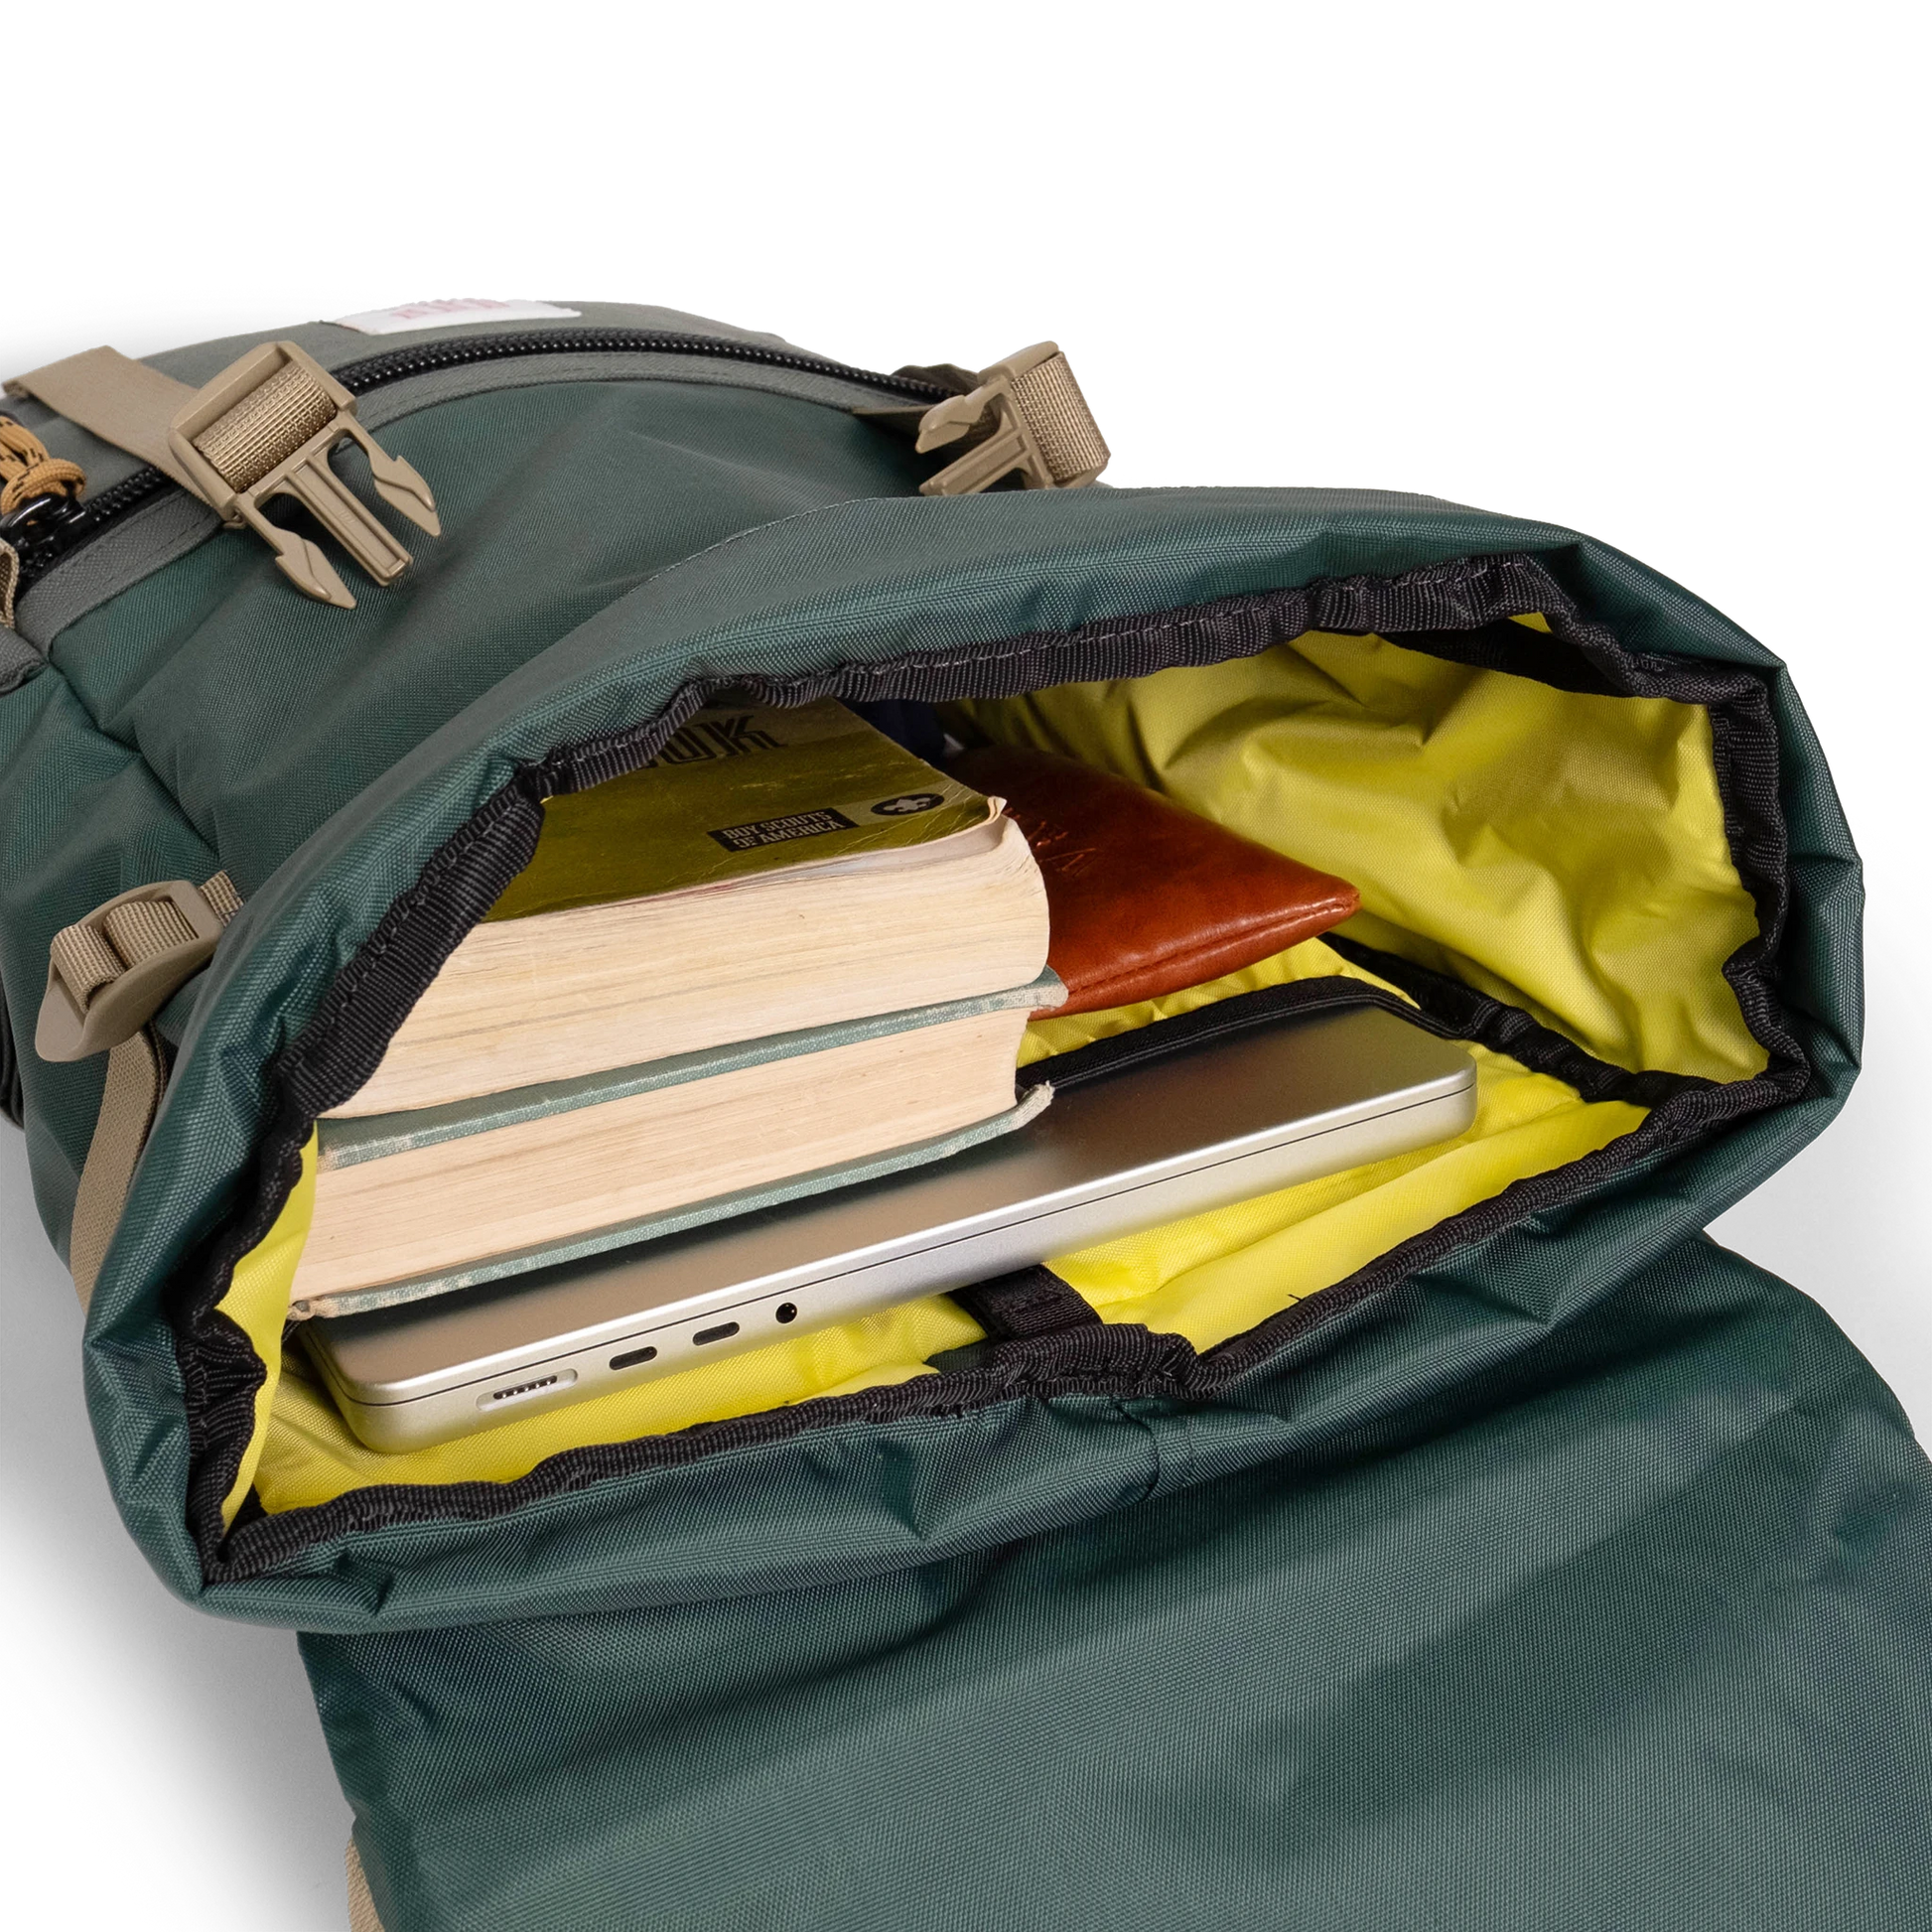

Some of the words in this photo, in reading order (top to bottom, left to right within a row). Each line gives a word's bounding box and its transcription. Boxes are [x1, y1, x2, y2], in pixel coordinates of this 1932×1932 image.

[722, 823, 760, 840] BOY
[760, 811, 833, 831] SCOUTS
[733, 836, 759, 848] OF
[759, 820, 846, 843] AMERICA
